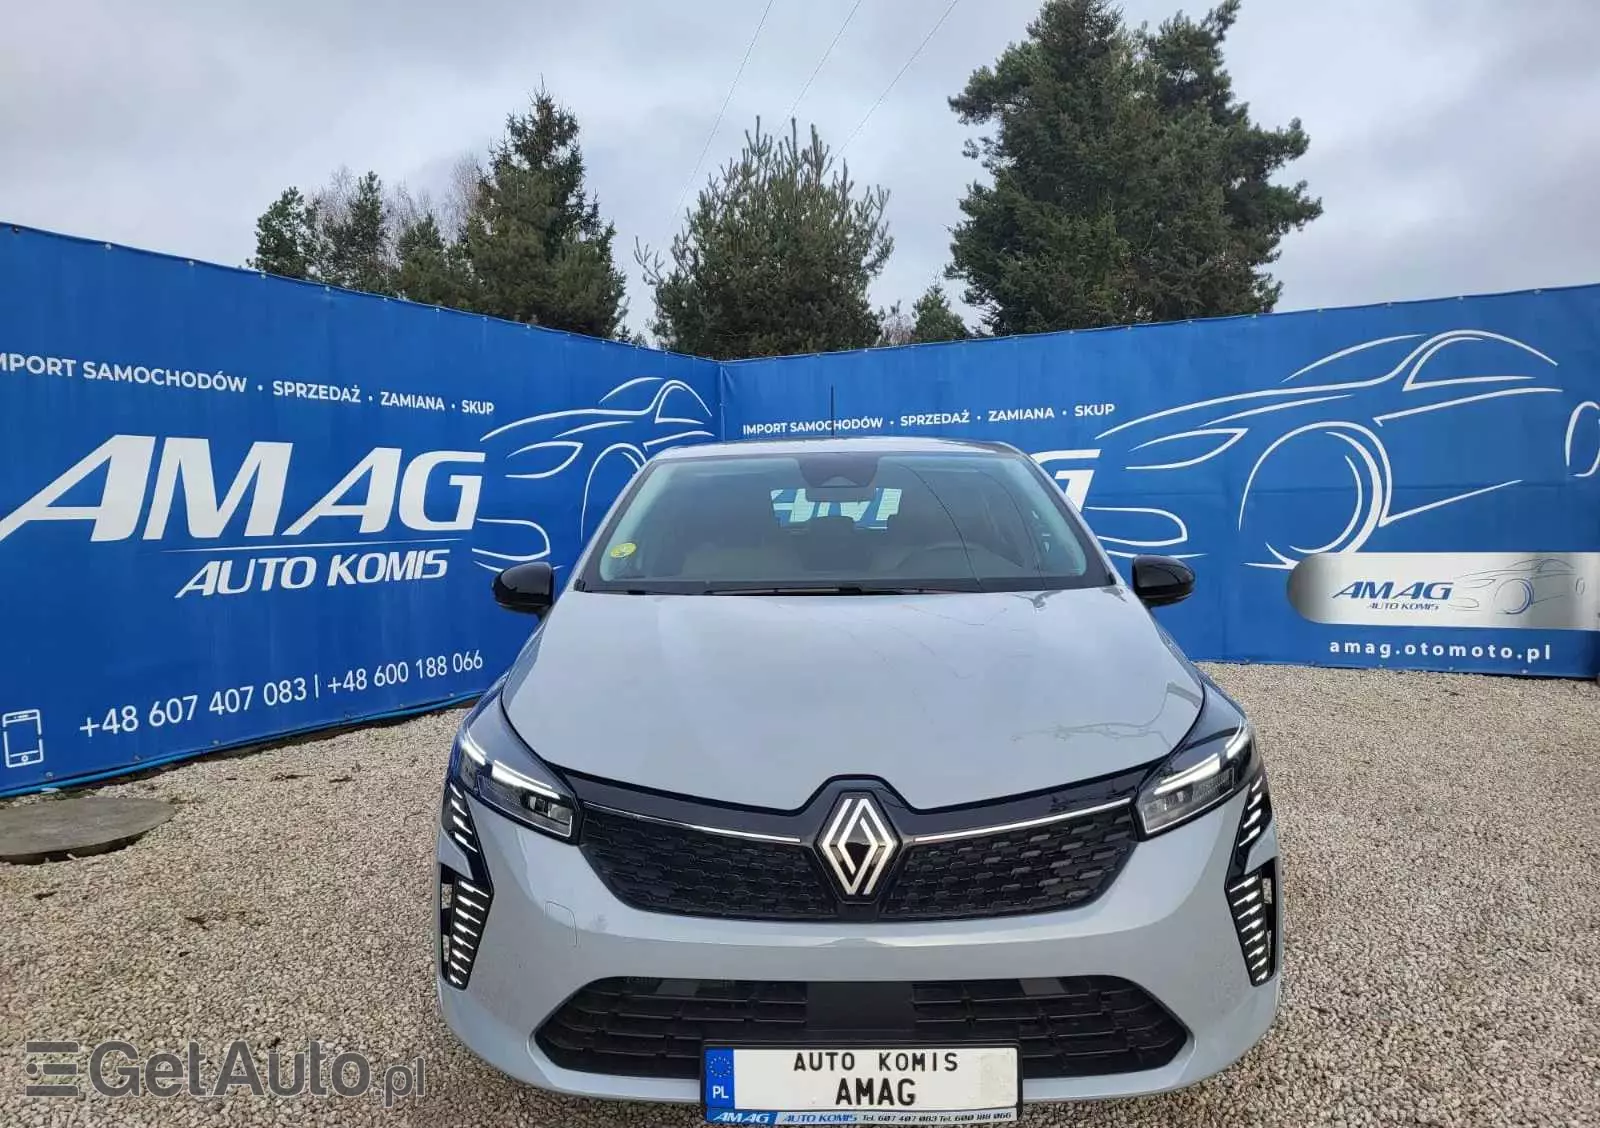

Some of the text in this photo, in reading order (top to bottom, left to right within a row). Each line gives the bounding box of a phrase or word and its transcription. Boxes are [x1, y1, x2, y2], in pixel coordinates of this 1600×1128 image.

[82, 360, 248, 393] SAMOCHODÓW
[272, 380, 361, 404] SPRZEDAŻ
[380, 391, 446, 412] ZAMIANA
[461, 400, 495, 416] SKUP
[743, 403, 1116, 435] IMPORT SAMOCHODÓW SPRZEDAŻ ZAMIANA SKUP
[0, 434, 487, 543] AMAG
[174, 548, 451, 599] AUTO KOMIS
[1332, 581, 1454, 600] AMAG
[1329, 640, 1551, 661] amag.otomoto.pl
[79, 649, 484, 738] +48 607 407 083 +48 600 188 066
[793, 1051, 958, 1072] AUTO KOMIS
[712, 1085, 730, 1099] PL
[834, 1077, 917, 1106] AMAG
[713, 1111, 769, 1123] AMAG
[783, 1114, 816, 1122] AUTO
[818, 1113, 858, 1122] KOMIS
